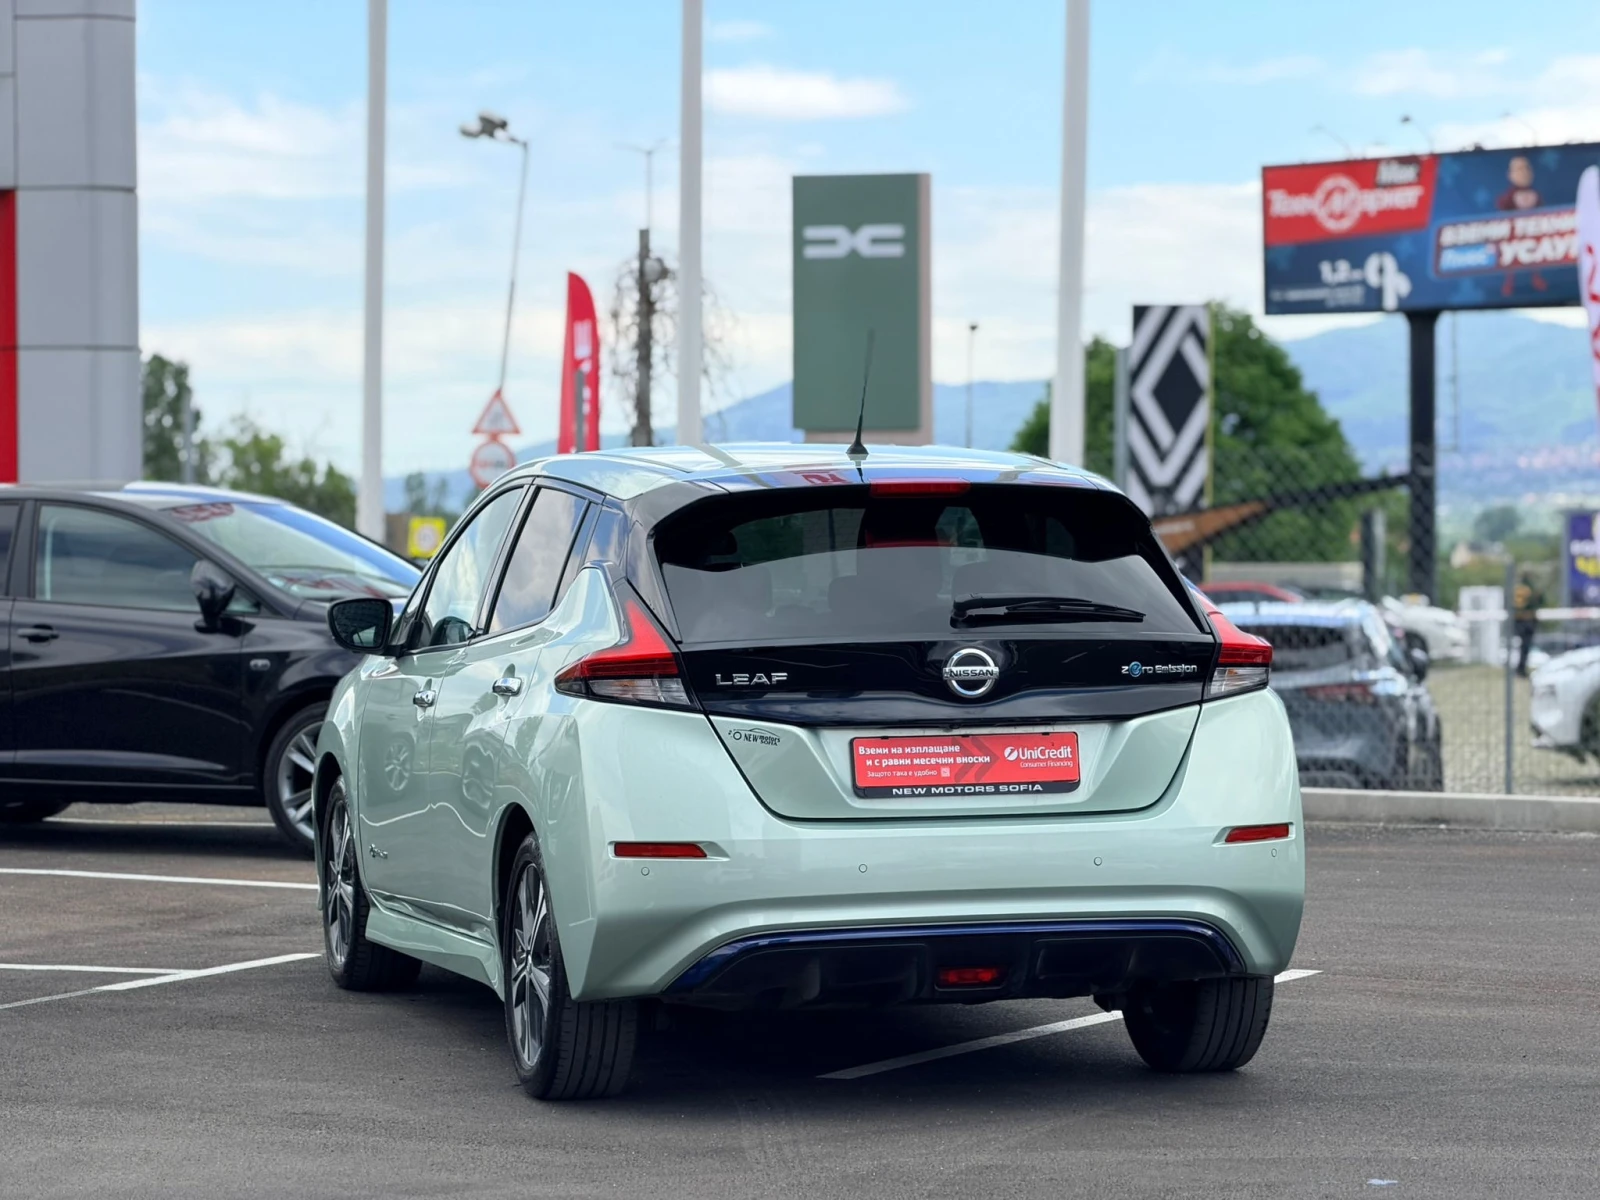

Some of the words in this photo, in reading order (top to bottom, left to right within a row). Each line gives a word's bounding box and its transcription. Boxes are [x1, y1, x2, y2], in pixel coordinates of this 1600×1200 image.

[950, 668, 994, 678] NISSAN
[715, 672, 788, 686] LEAF
[744, 732, 759, 743] NEW
[858, 746, 889, 755] Вземи
[891, 746, 903, 754] на
[904, 745, 960, 755] изплащане
[1019, 746, 1073, 760] UniCredit
[882, 758, 912, 768] равни
[913, 757, 954, 766] месечни
[956, 755, 990, 764] вноски
[1020, 760, 1047, 768] Consumer
[1048, 760, 1073, 769] Financing
[867, 770, 892, 778] Защото
[914, 769, 938, 777] удобно
[892, 787, 927, 795] NEW
[931, 785, 995, 794] MOTORS
[999, 783, 1043, 792] SOFIA
